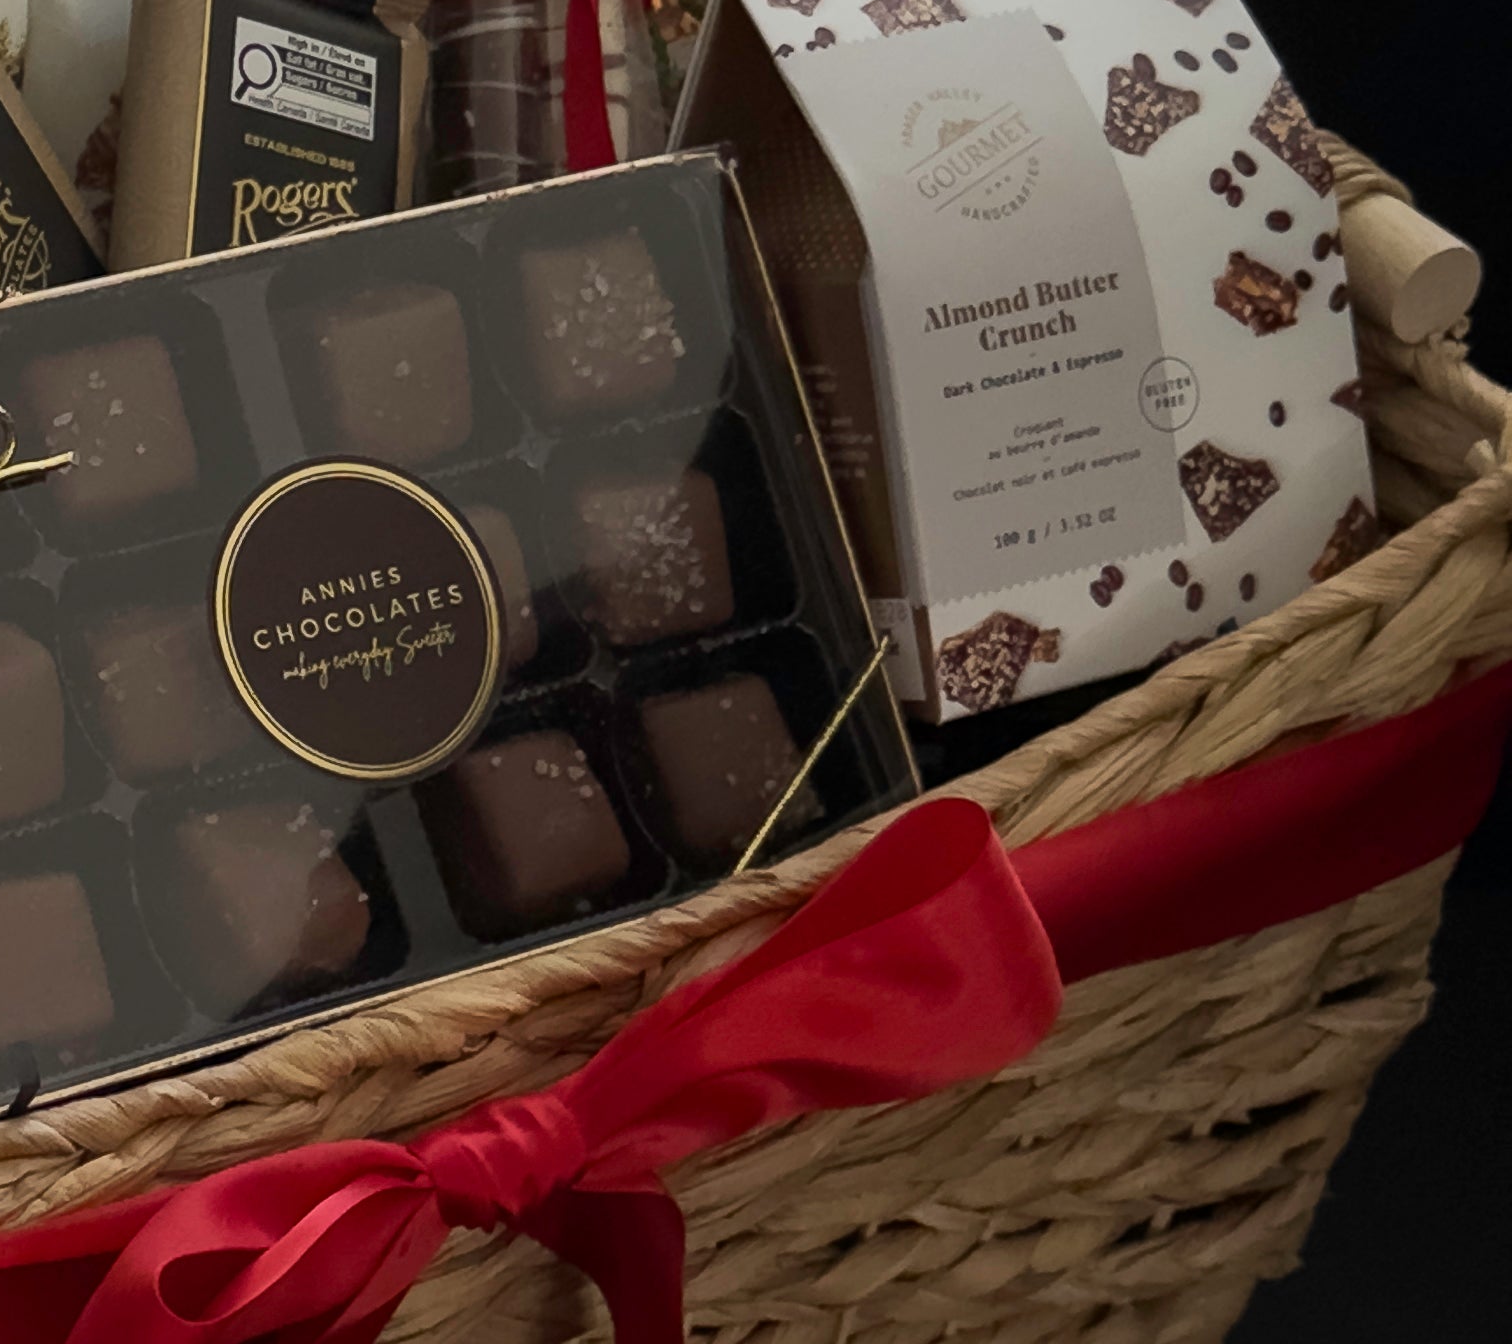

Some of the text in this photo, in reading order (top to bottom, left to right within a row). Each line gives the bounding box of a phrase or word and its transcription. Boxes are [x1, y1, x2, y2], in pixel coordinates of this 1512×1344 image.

[244, 133, 326, 165] ESTABLISHED
[917, 111, 1032, 199] GOURMET
[229, 177, 359, 247] Rogers'
[924, 272, 1120, 332] Almond Butter
[979, 309, 1077, 351] Crunch
[943, 381, 974, 398] Dark
[980, 367, 1046, 390] Chocolate
[1145, 376, 1191, 397] GLUTEN
[1155, 394, 1185, 411] FREE
[302, 566, 401, 605] ANNIES
[253, 584, 463, 649] CHOCOLATES
[283, 651, 330, 690] making
